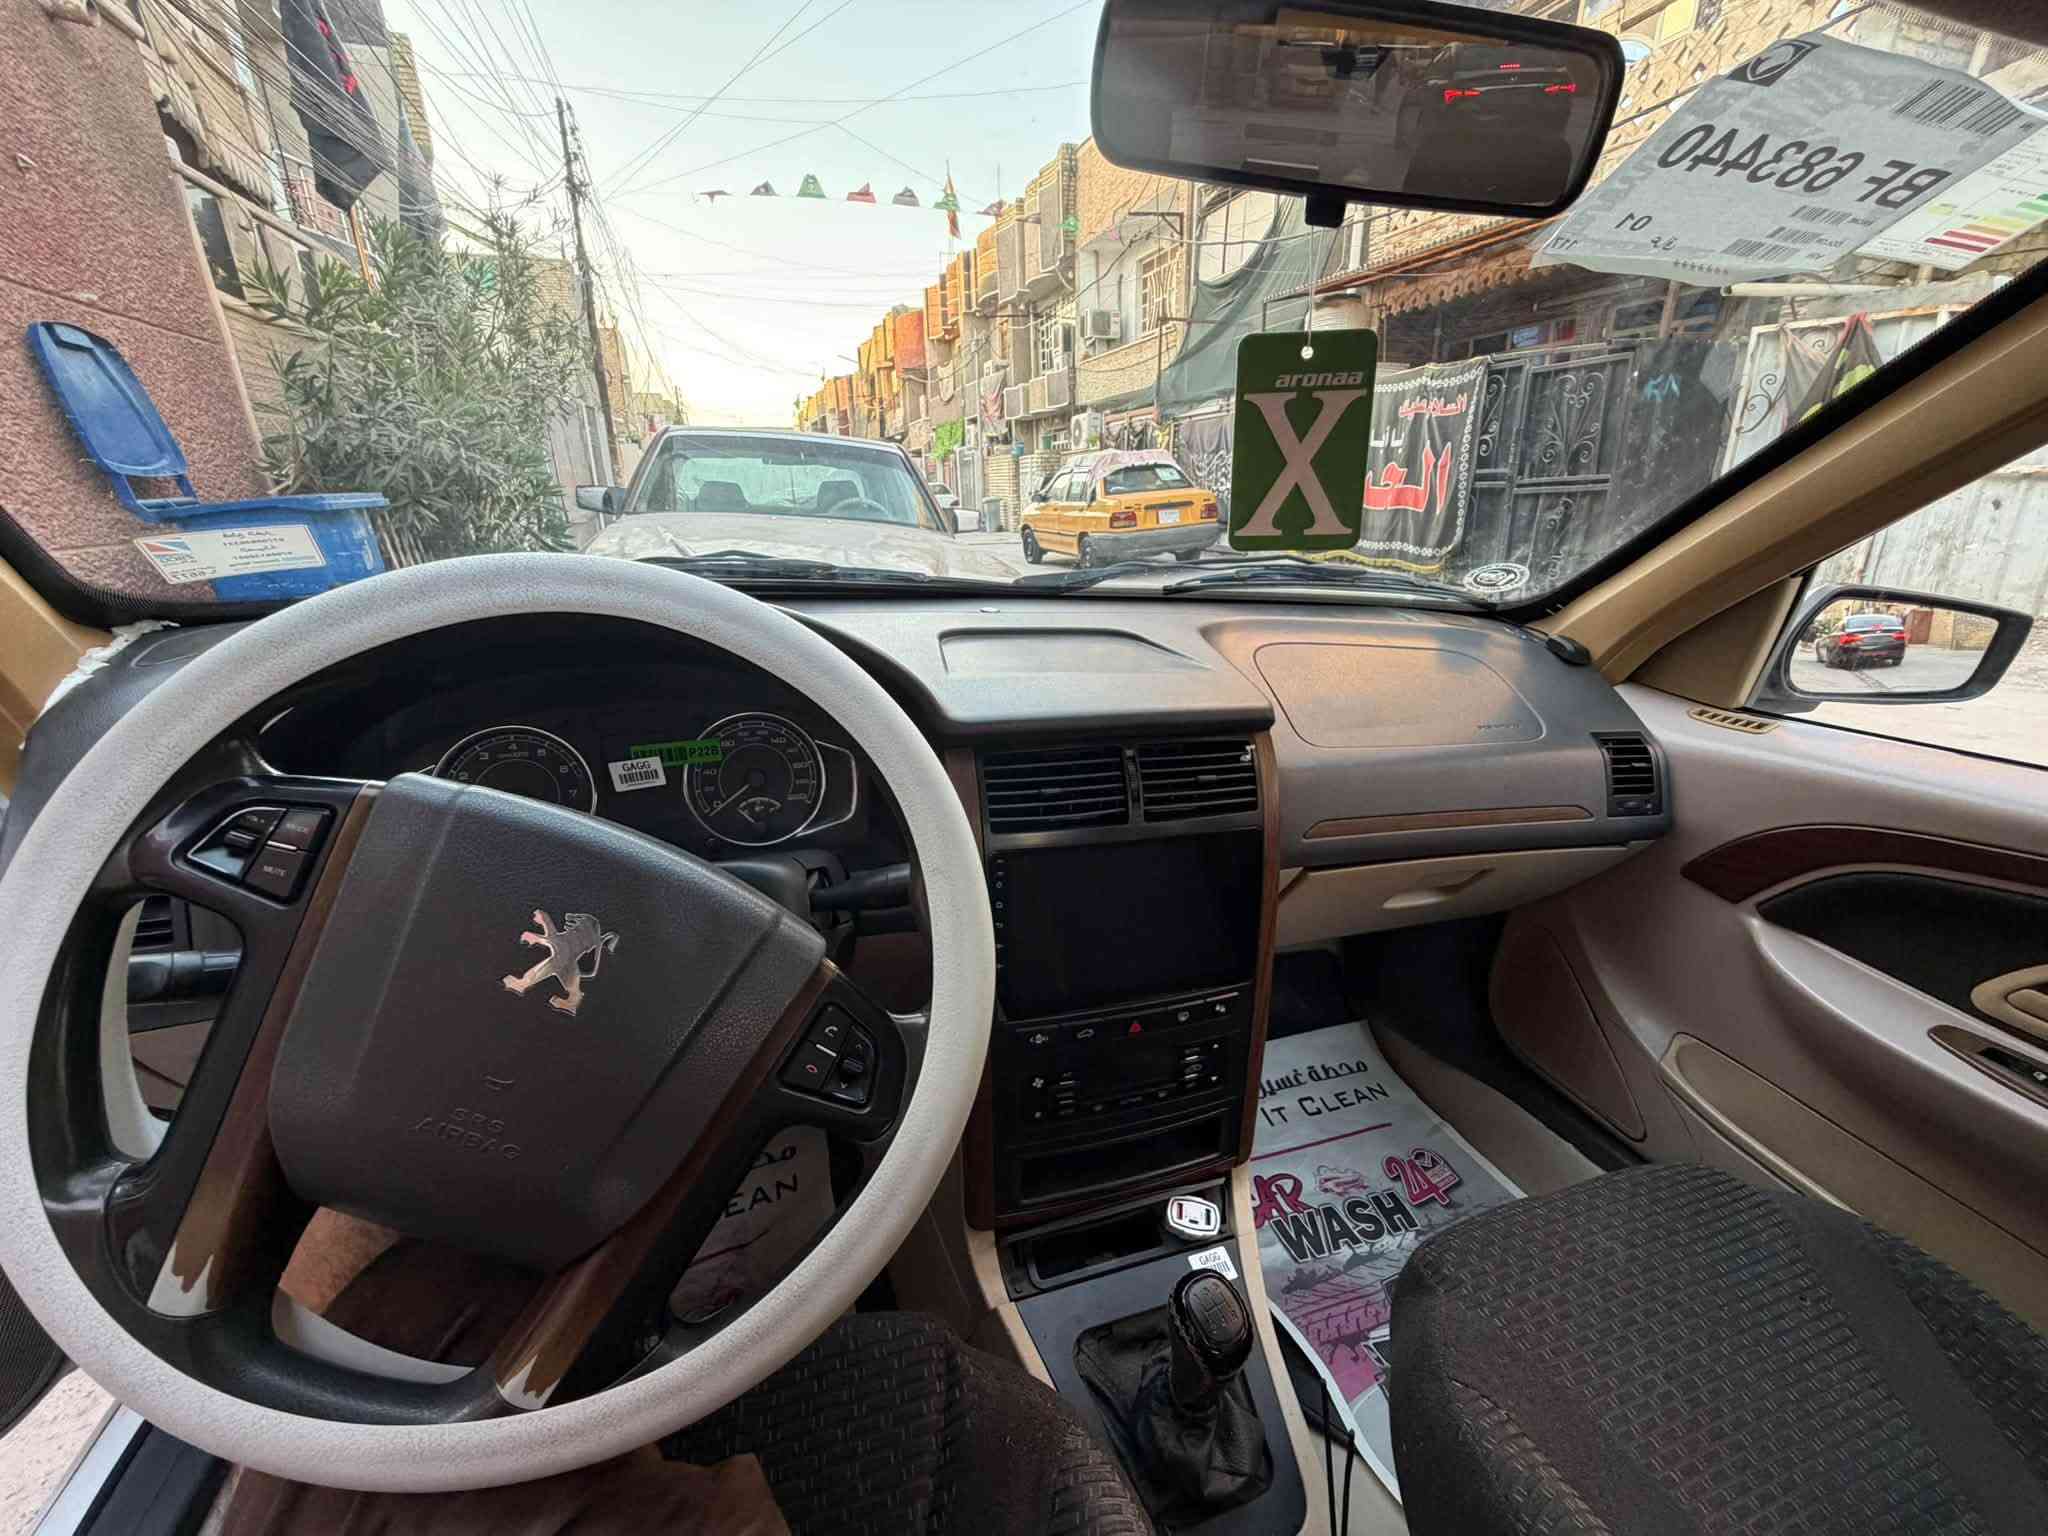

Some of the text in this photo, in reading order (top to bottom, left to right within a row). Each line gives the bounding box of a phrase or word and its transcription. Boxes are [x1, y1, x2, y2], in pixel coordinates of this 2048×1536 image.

[1275, 371, 1364, 388] aronaa
[1233, 390, 1367, 536] X
[1363, 441, 1452, 514] الح
[1260, 1106, 1290, 1128] IT
[724, 1172, 799, 1218] EAN
[1251, 1172, 1309, 1229] AR
[1271, 1190, 1420, 1263] WASH
